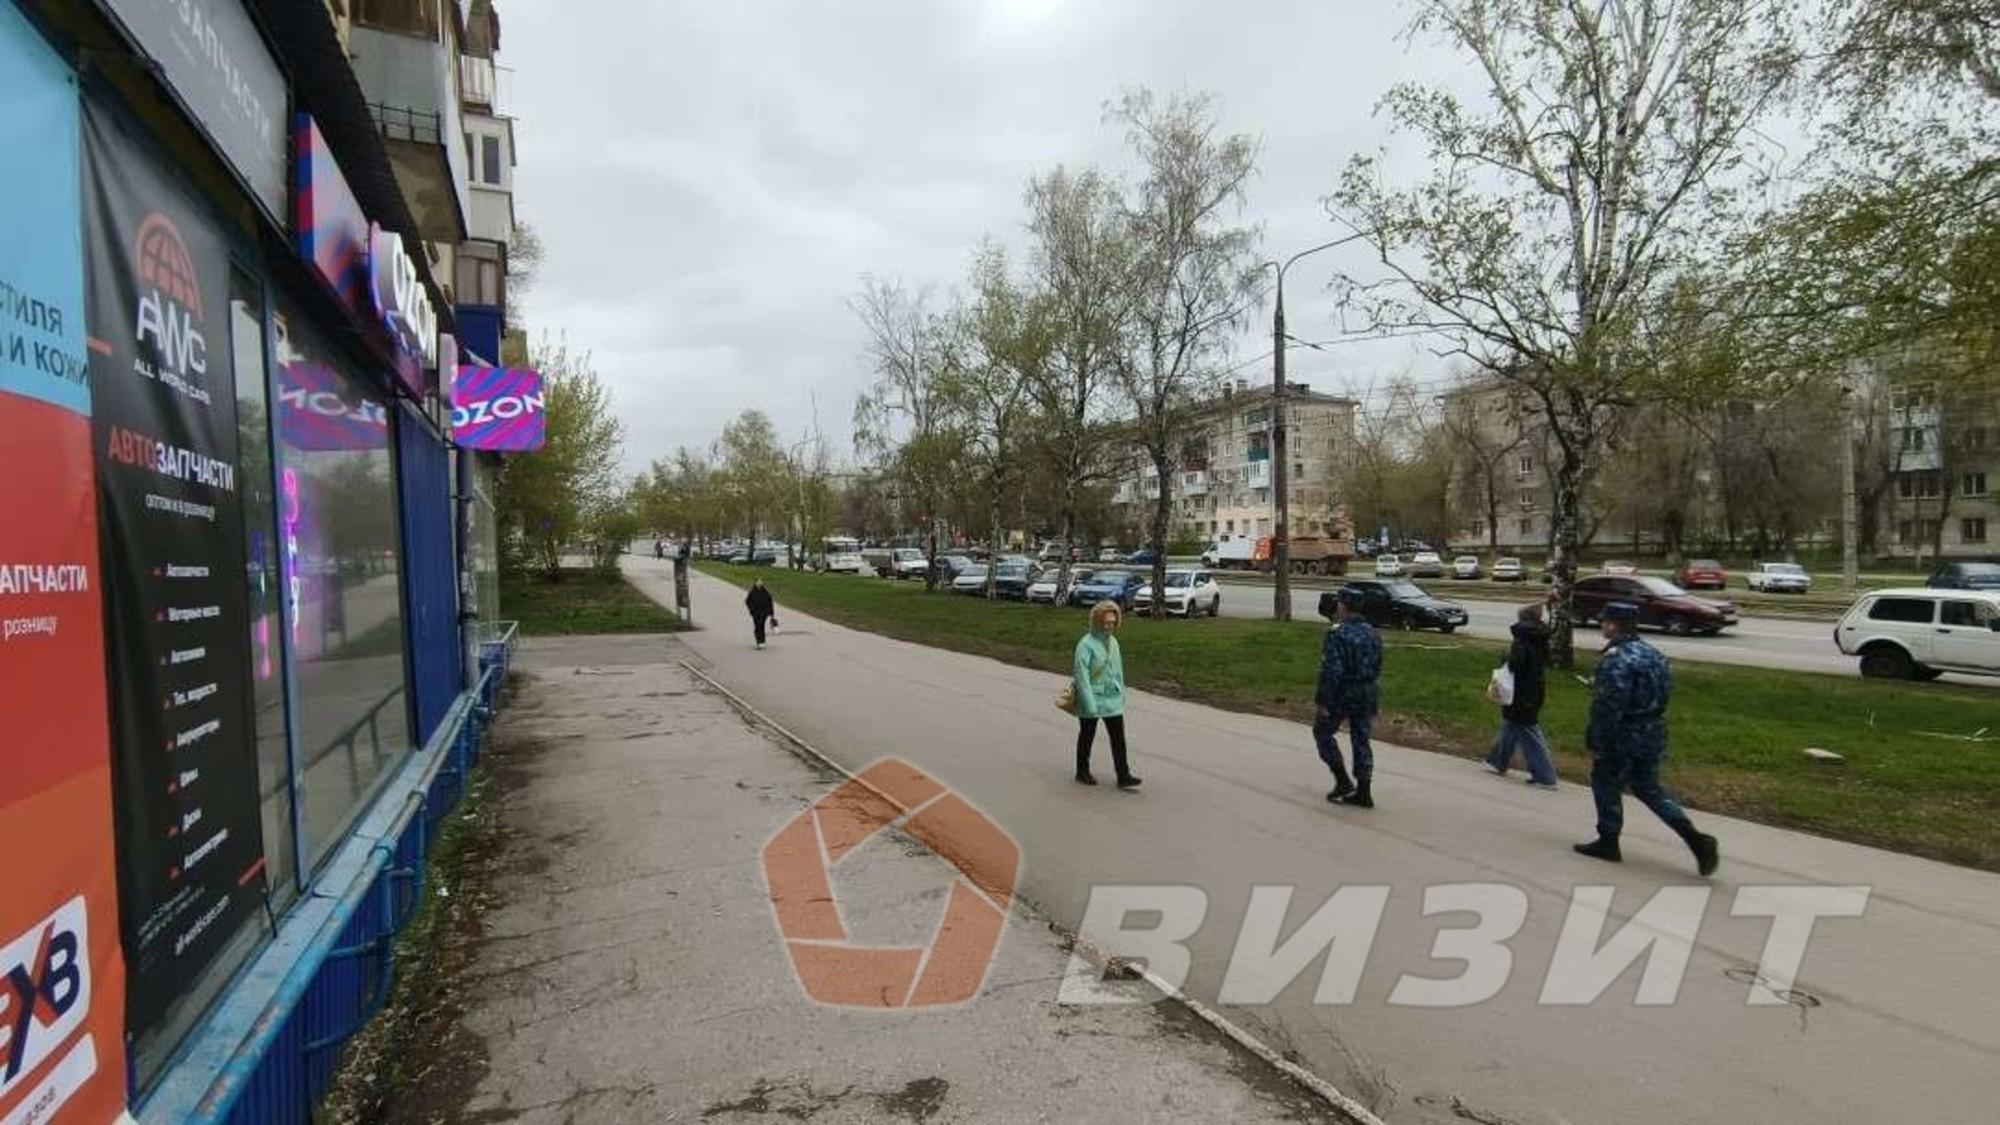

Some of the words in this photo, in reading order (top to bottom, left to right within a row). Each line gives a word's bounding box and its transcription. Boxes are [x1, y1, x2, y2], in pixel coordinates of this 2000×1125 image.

[172, 0, 270, 144] ЗАПЧАСТИ
[0, 280, 62, 336] ТИЛЯ
[452, 393, 545, 428] OZON
[108, 425, 234, 491] АВТОЗАПЧАСТИ
[4, 616, 58, 641] розницу
